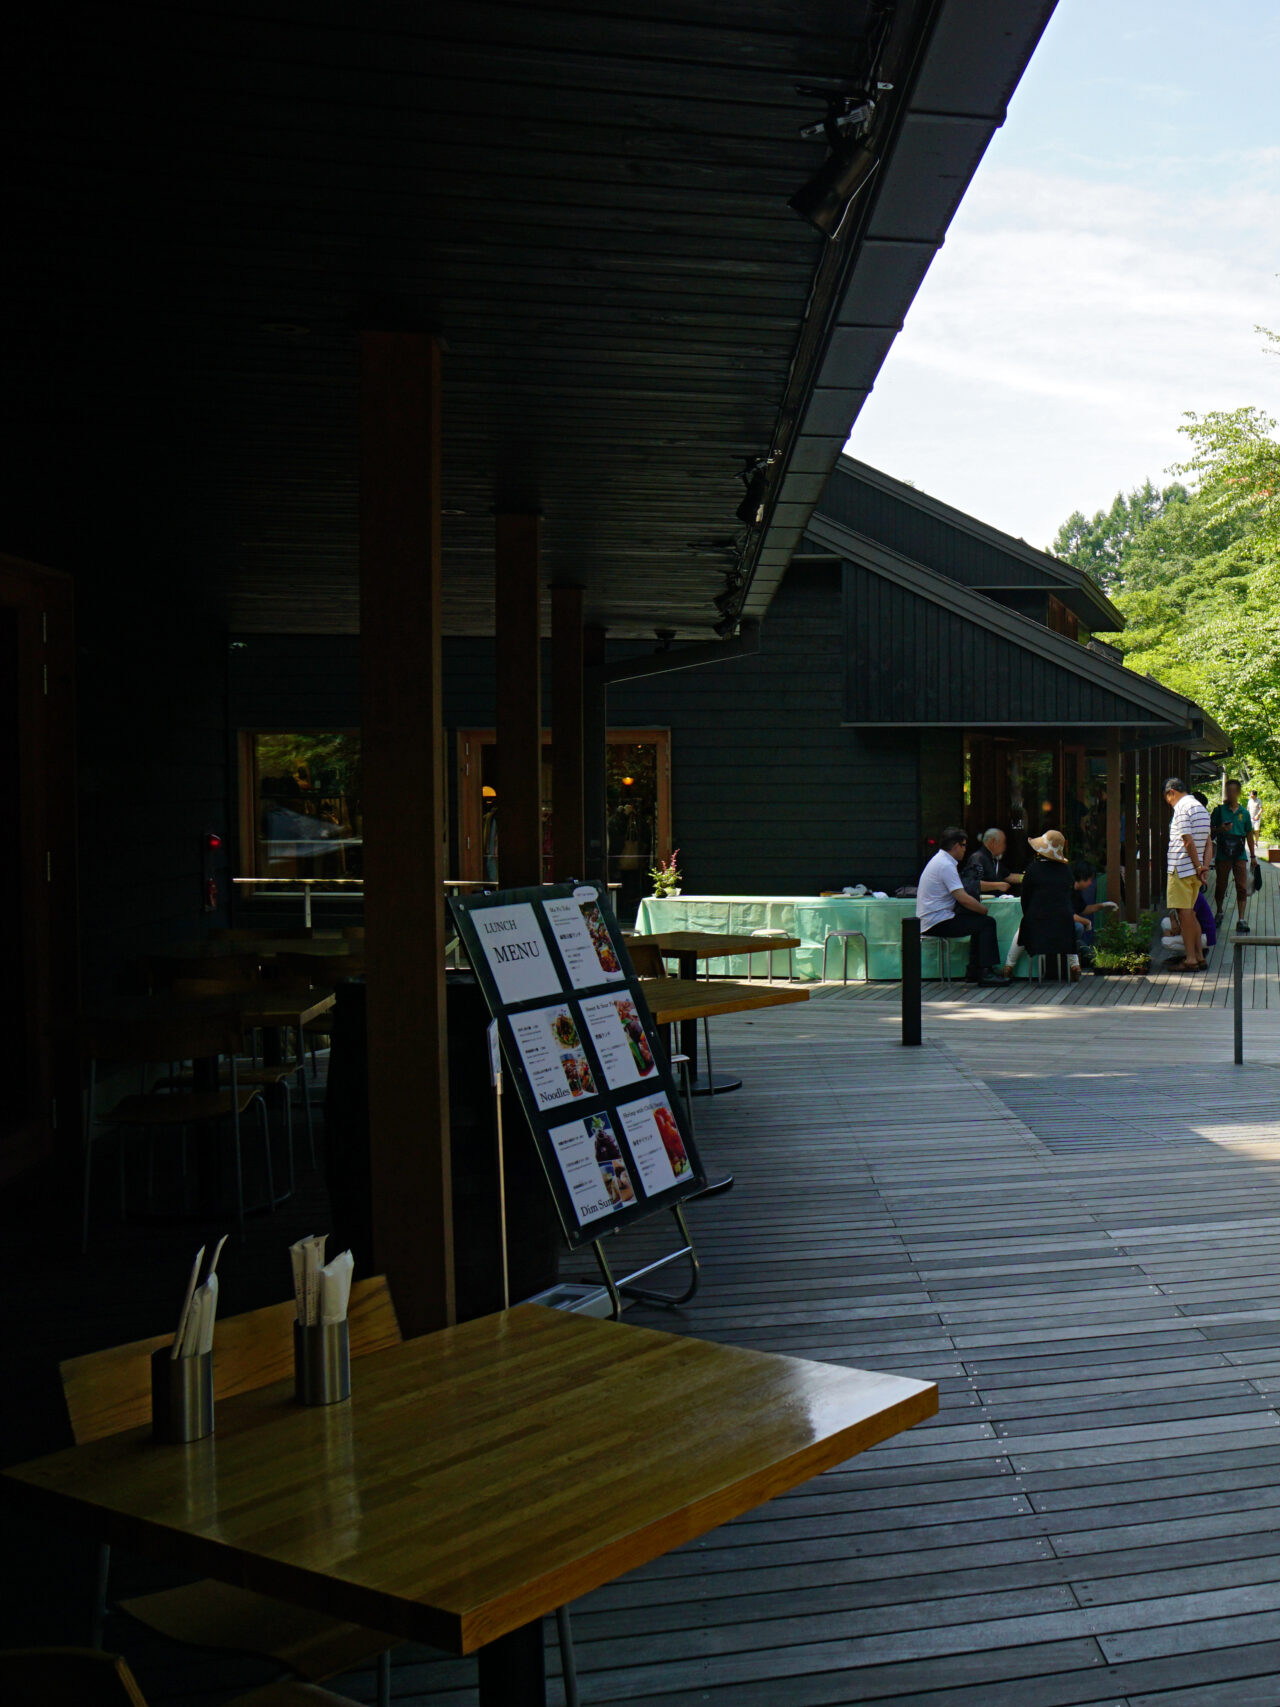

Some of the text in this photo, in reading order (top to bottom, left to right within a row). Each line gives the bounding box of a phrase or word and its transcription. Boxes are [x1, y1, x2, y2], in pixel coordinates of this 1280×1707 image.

[484, 920, 517, 934] LUNCH
[492, 941, 540, 963] MENU
[540, 1088, 571, 1103] Noodles
[580, 1198, 615, 1217] Dim Sum
